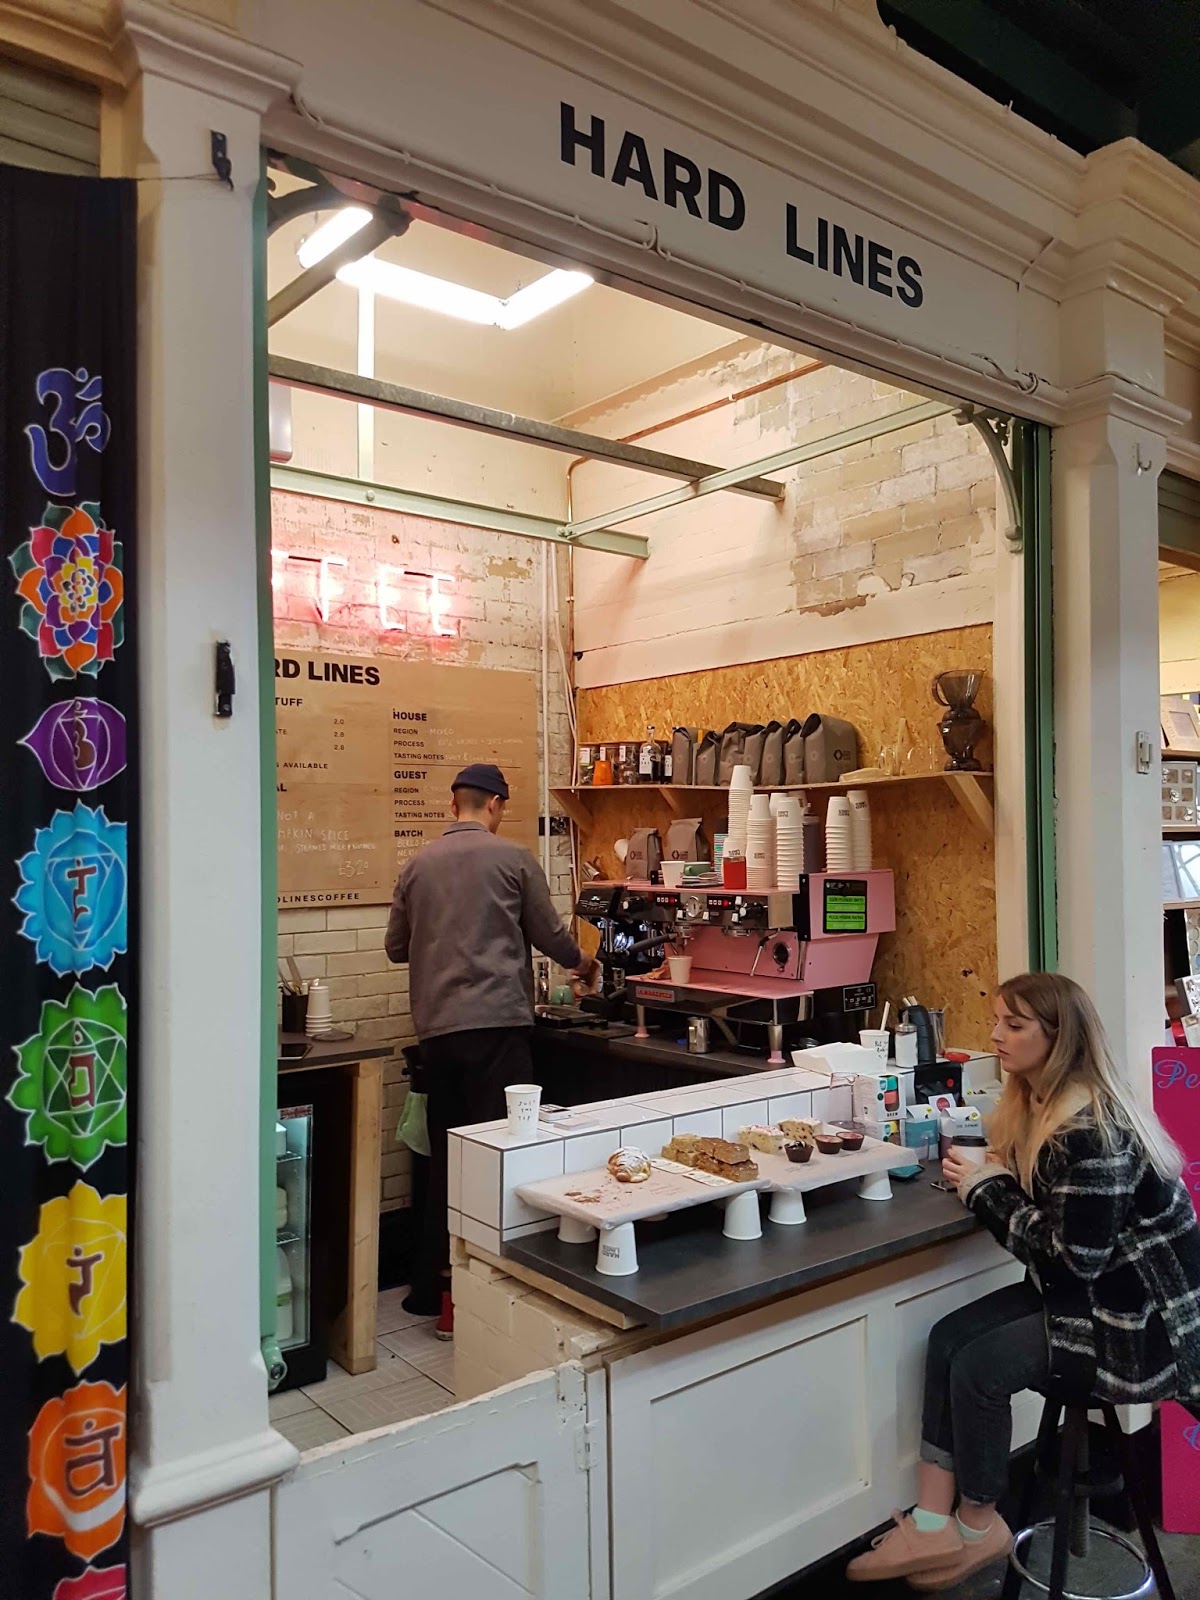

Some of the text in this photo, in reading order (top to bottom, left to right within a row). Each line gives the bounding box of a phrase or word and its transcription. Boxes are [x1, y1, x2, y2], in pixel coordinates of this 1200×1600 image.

[561, 101, 924, 308] HARD LINES
[308, 661, 381, 686] LINES
[393, 711, 427, 721] HOUSE
[423, 753, 445, 761] NOTES
[394, 770, 427, 780] GUEST
